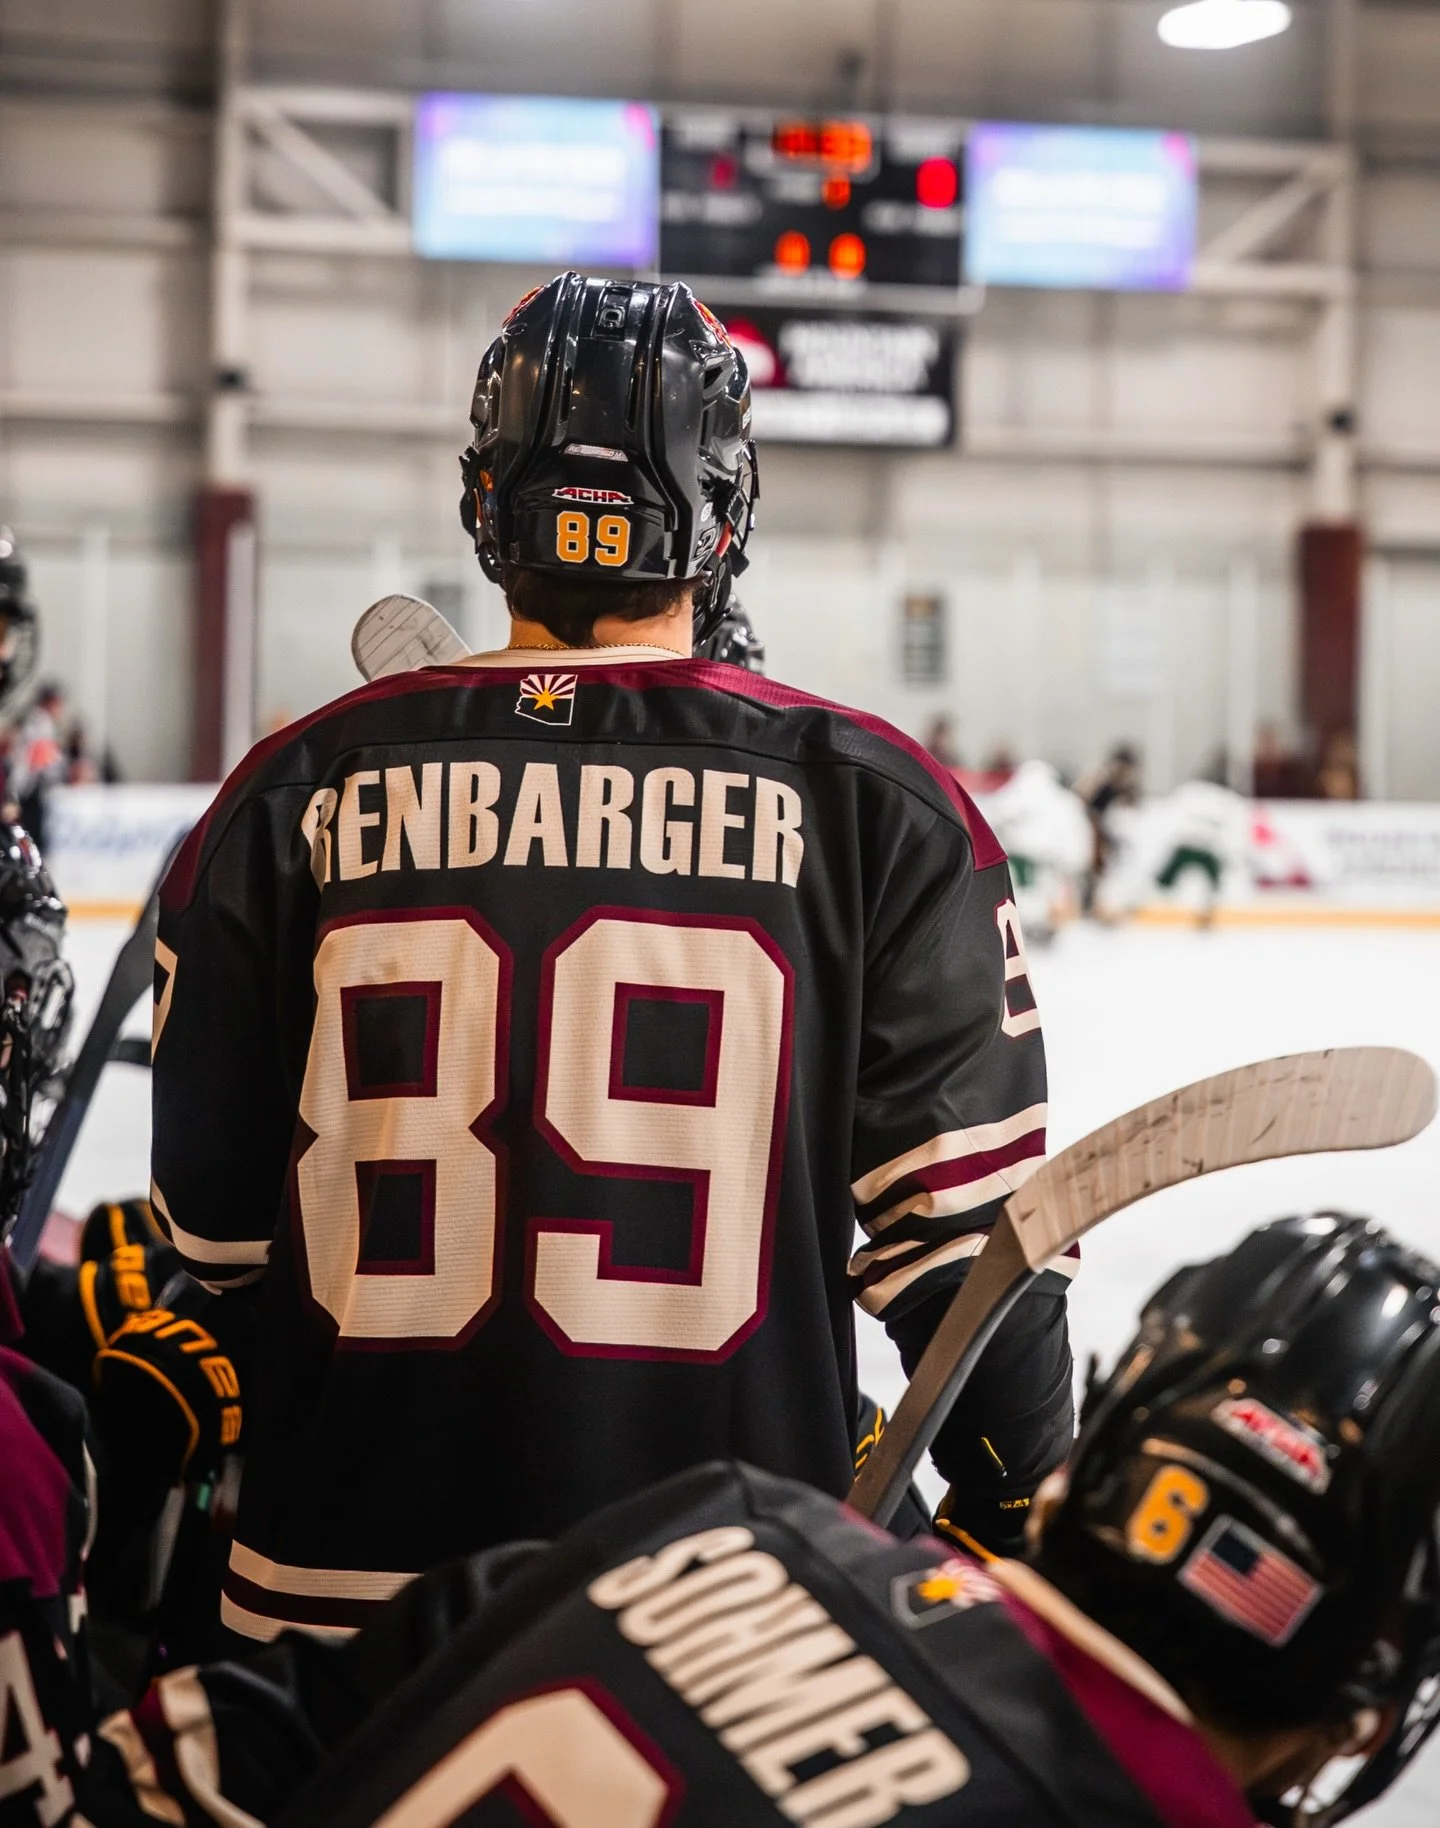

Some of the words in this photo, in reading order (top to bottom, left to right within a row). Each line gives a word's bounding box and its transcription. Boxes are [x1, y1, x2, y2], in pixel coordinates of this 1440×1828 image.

[556, 487, 631, 503] ACHA
[556, 510, 631, 567] 89
[292, 907, 794, 1362] 89
[1127, 1464, 1209, 1565] 6
